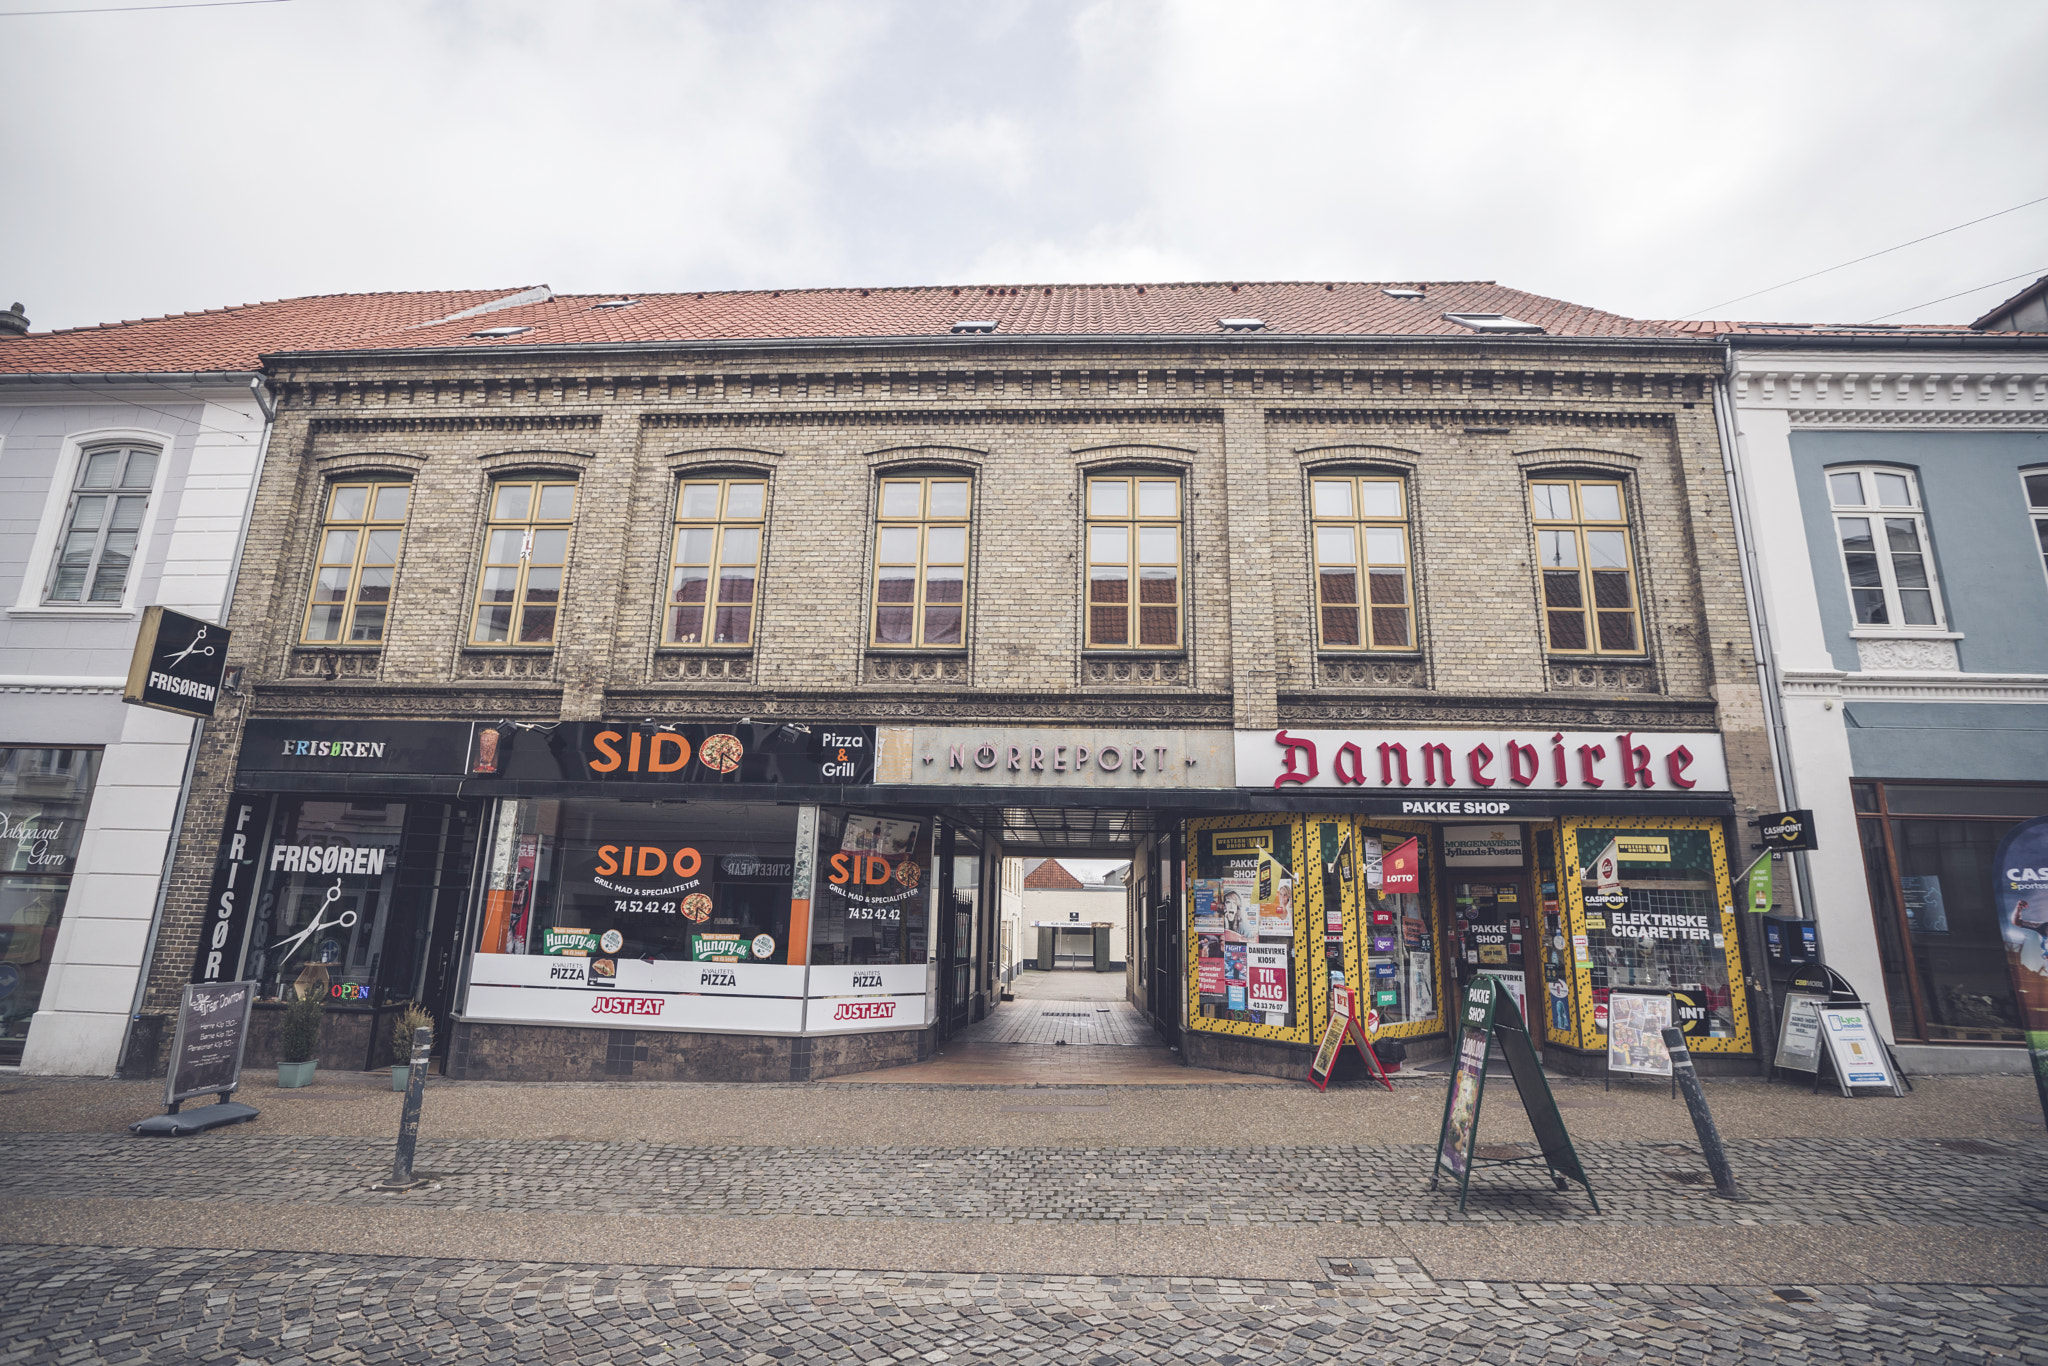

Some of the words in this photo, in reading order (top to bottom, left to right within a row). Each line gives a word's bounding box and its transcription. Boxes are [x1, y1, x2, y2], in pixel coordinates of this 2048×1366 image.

[149, 671, 215, 701] FRISØREN
[823, 733, 863, 747] Pizza
[282, 739, 386, 758] FRISØREN
[837, 748, 848, 762] &
[1274, 729, 1697, 790] Dannevirke
[822, 762, 855, 777] Grill
[1402, 802, 1460, 813] PAKKE
[1464, 802, 1510, 814] SHOP
[1764, 824, 1802, 835] CASHPOINT
[28, 840, 67, 866] Garn
[270, 845, 385, 875] FRISØREN
[595, 845, 702, 877] SIDO
[1233, 870, 1256, 878] SHOP
[1387, 874, 1413, 883] LOTTO
[594, 876, 613, 890] GRILL
[614, 884, 632, 894] MAD
[641, 879, 700, 896] SPECIALITETER
[829, 883, 846, 897] GRILL
[848, 892, 863, 901] MAD
[871, 888, 919, 903] SPECIALITETER
[614, 900, 627, 912] 74
[629, 901, 643, 912] 52
[645, 901, 659, 913] 42
[662, 902, 676, 913] 42
[849, 907, 859, 919] 74
[861, 908, 873, 919] 52
[875, 908, 887, 919] 42
[889, 909, 900, 920] 42
[1612, 912, 1709, 928] ELEKTRISKE
[1472, 925, 1507, 933] PAKKE
[1611, 925, 1710, 940] CIGARETTER
[546, 933, 596, 952] Hungry.dk
[1476, 935, 1504, 943] SHOP
[695, 940, 747, 959] Hungry.dk
[1249, 947, 1285, 955] DANNEVIRKE
[550, 968, 584, 980] PIZZA
[701, 974, 736, 986] PIZZA
[1259, 969, 1276, 983] TIL
[853, 976, 882, 987] PIZZA
[331, 984, 370, 999] OPEN
[1253, 984, 1283, 999] SALG
[1468, 988, 1490, 1004] PAKKE
[1336, 994, 1347, 1007] BT
[1468, 1007, 1486, 1022] SHOP
[1840, 1016, 1862, 1024] Lyca
